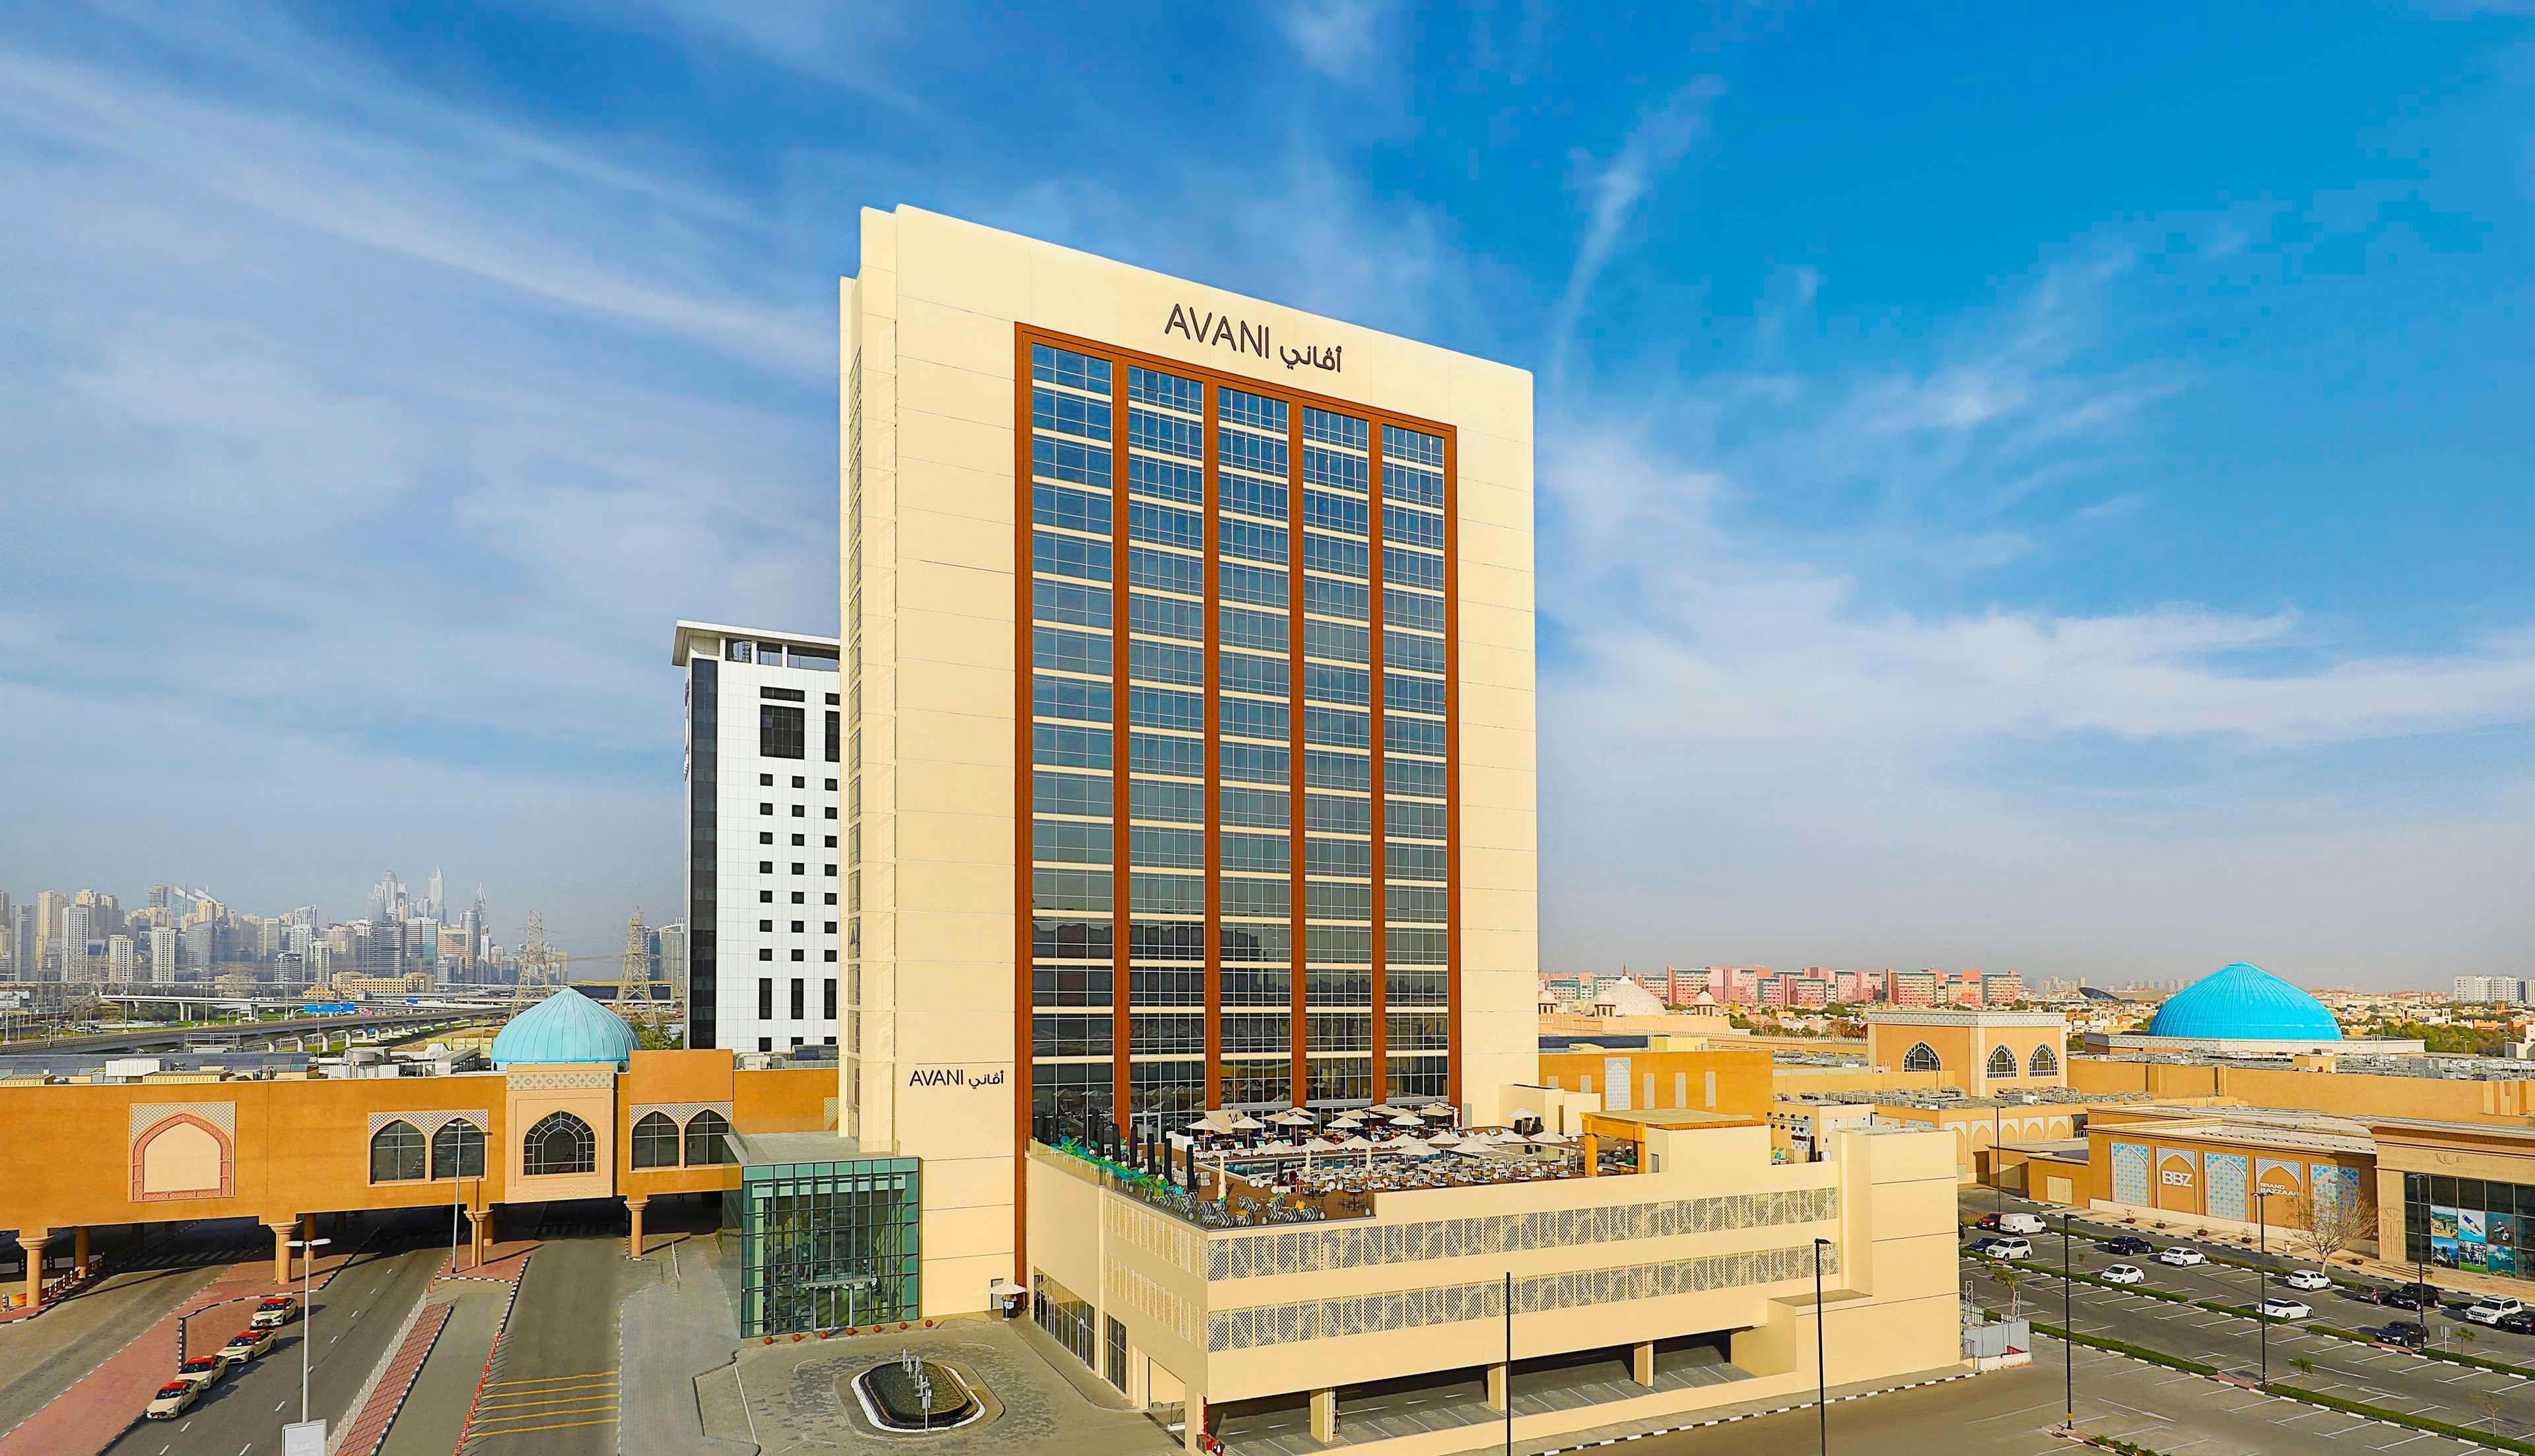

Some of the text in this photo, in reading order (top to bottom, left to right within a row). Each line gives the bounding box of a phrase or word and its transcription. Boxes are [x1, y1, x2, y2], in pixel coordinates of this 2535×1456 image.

[1165, 303, 1269, 359] AVANI
[909, 1069, 963, 1086] AVANI
[2162, 1170, 2193, 1187] BBZ
